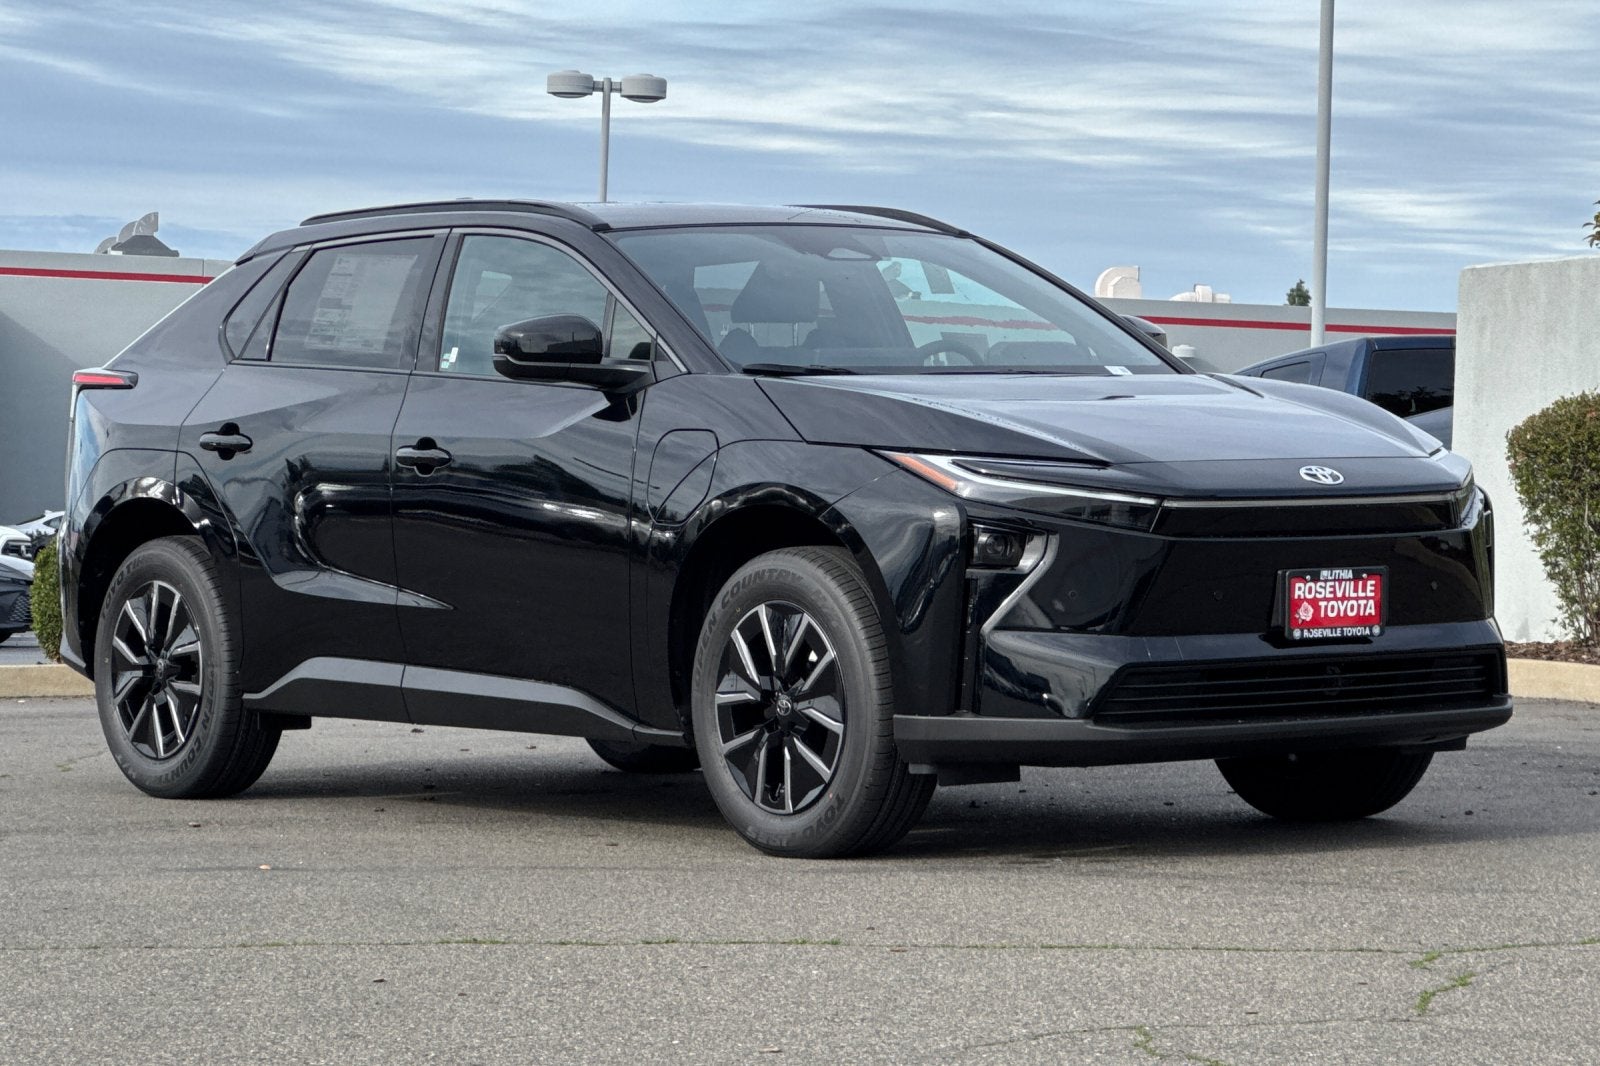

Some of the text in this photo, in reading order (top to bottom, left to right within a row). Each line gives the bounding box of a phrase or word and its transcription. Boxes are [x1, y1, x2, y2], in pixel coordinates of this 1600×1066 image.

[1328, 569, 1353, 580] LITHIA
[1294, 580, 1376, 599] ROSEVILLE
[1318, 600, 1376, 618] TOYOTA
[1303, 627, 1370, 638] ROSEVILLE TOYOTA
[694, 609, 717, 687] OPEN
